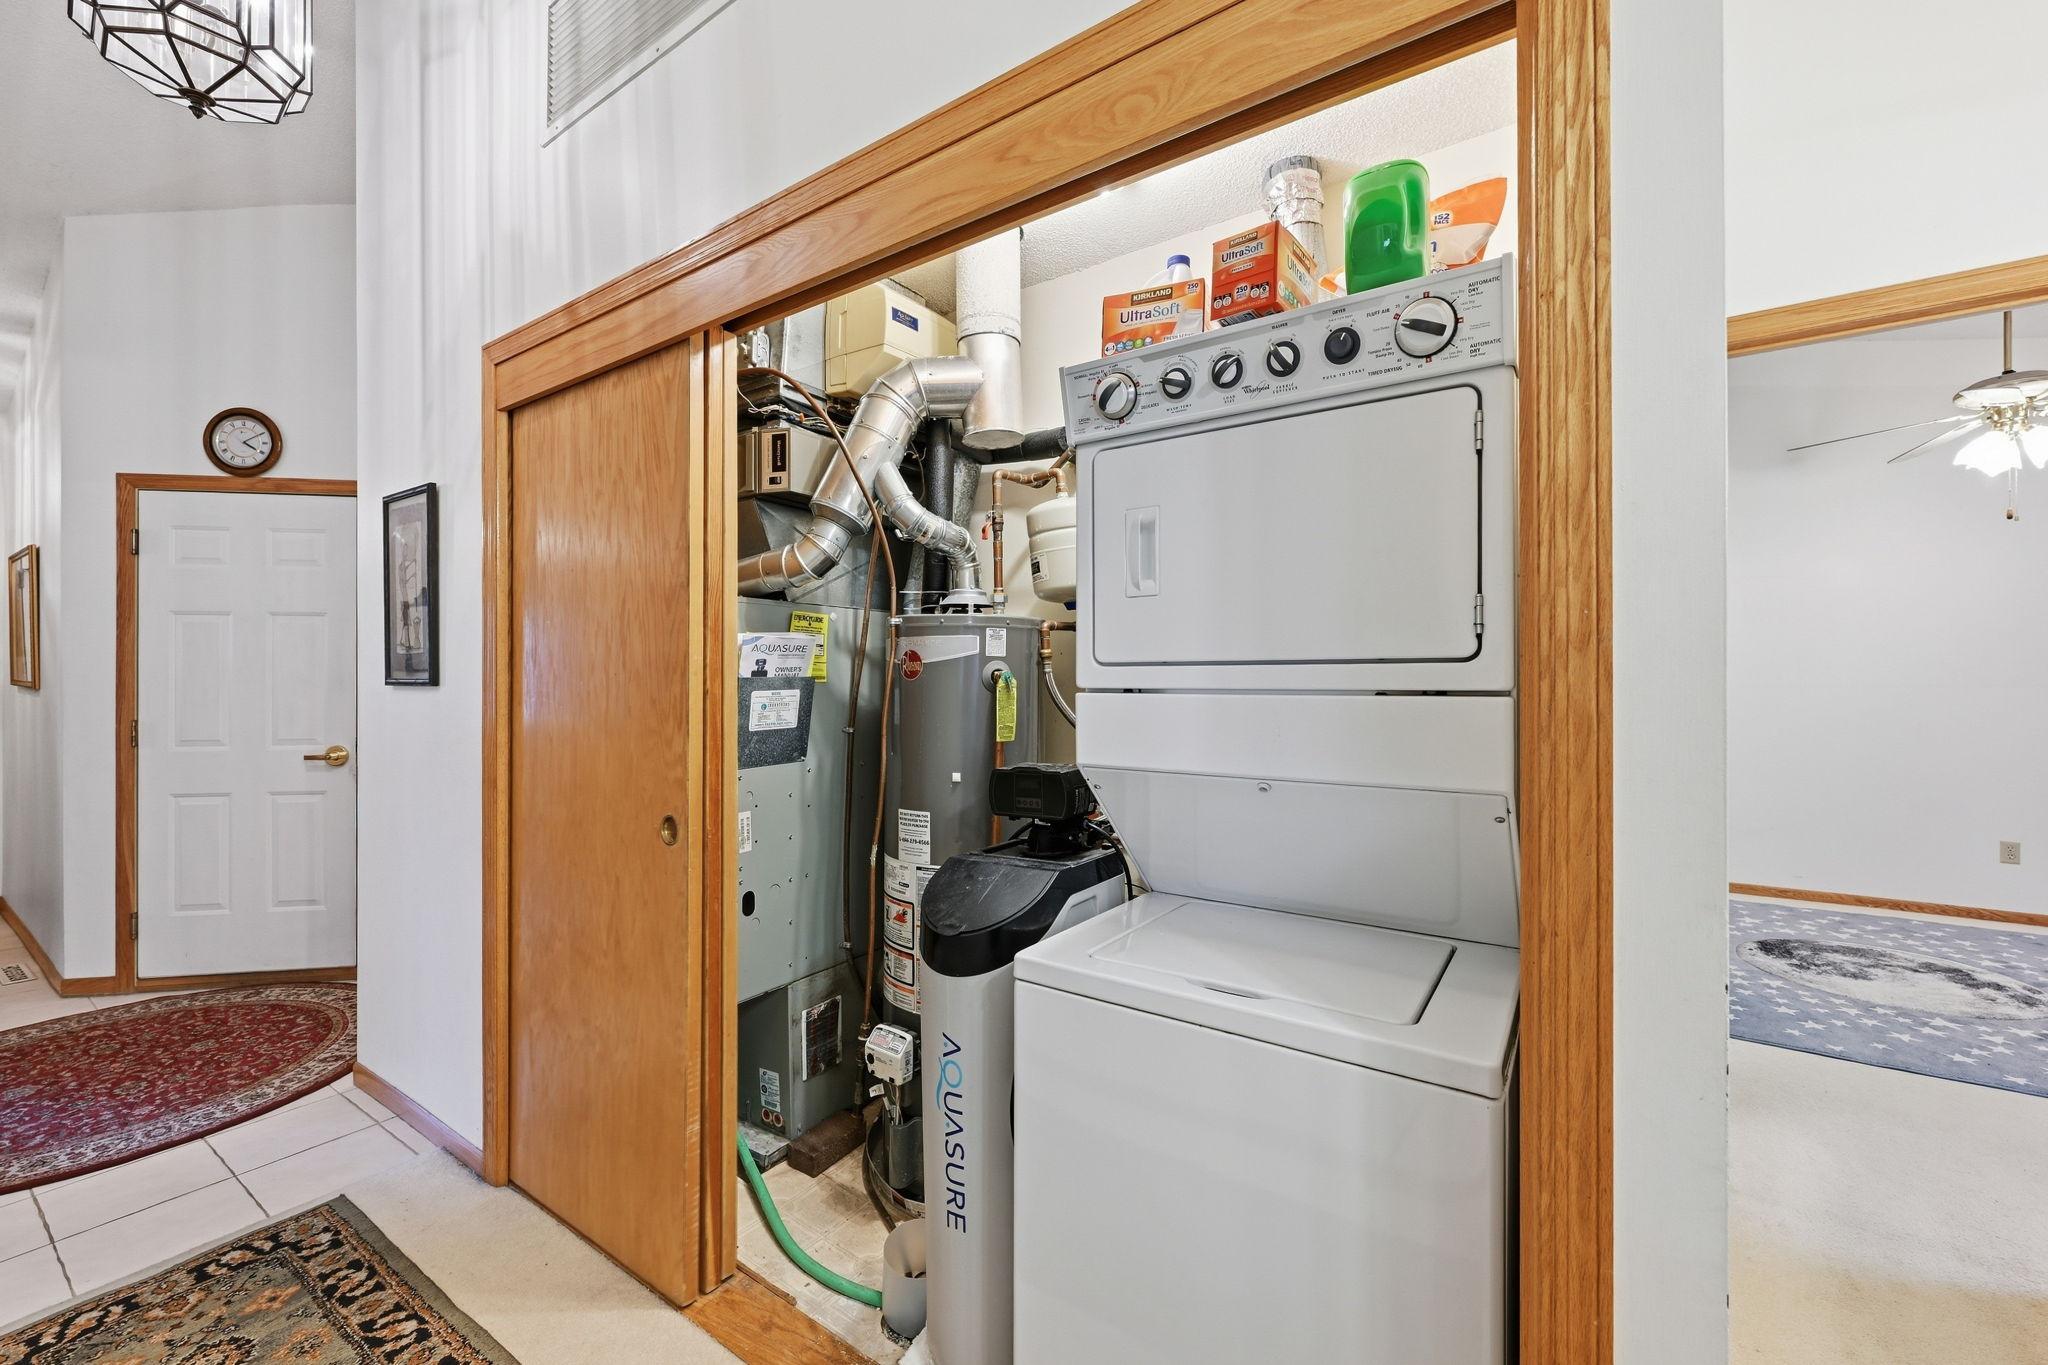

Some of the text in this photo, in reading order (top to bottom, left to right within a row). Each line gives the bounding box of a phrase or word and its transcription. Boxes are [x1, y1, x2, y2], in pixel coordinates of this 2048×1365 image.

[1221, 241, 1264, 263] UltraSoft
[1468, 276, 1500, 288] AUTOMATIC
[1132, 288, 1172, 302] KIRKLAND
[1236, 285, 1248, 294] 250
[1120, 302, 1181, 324] UltraSoft
[1469, 338, 1501, 349] AUTOMATIC
[751, 643, 808, 656] AQUASURE
[936, 1031, 967, 1234] AQUASURE
